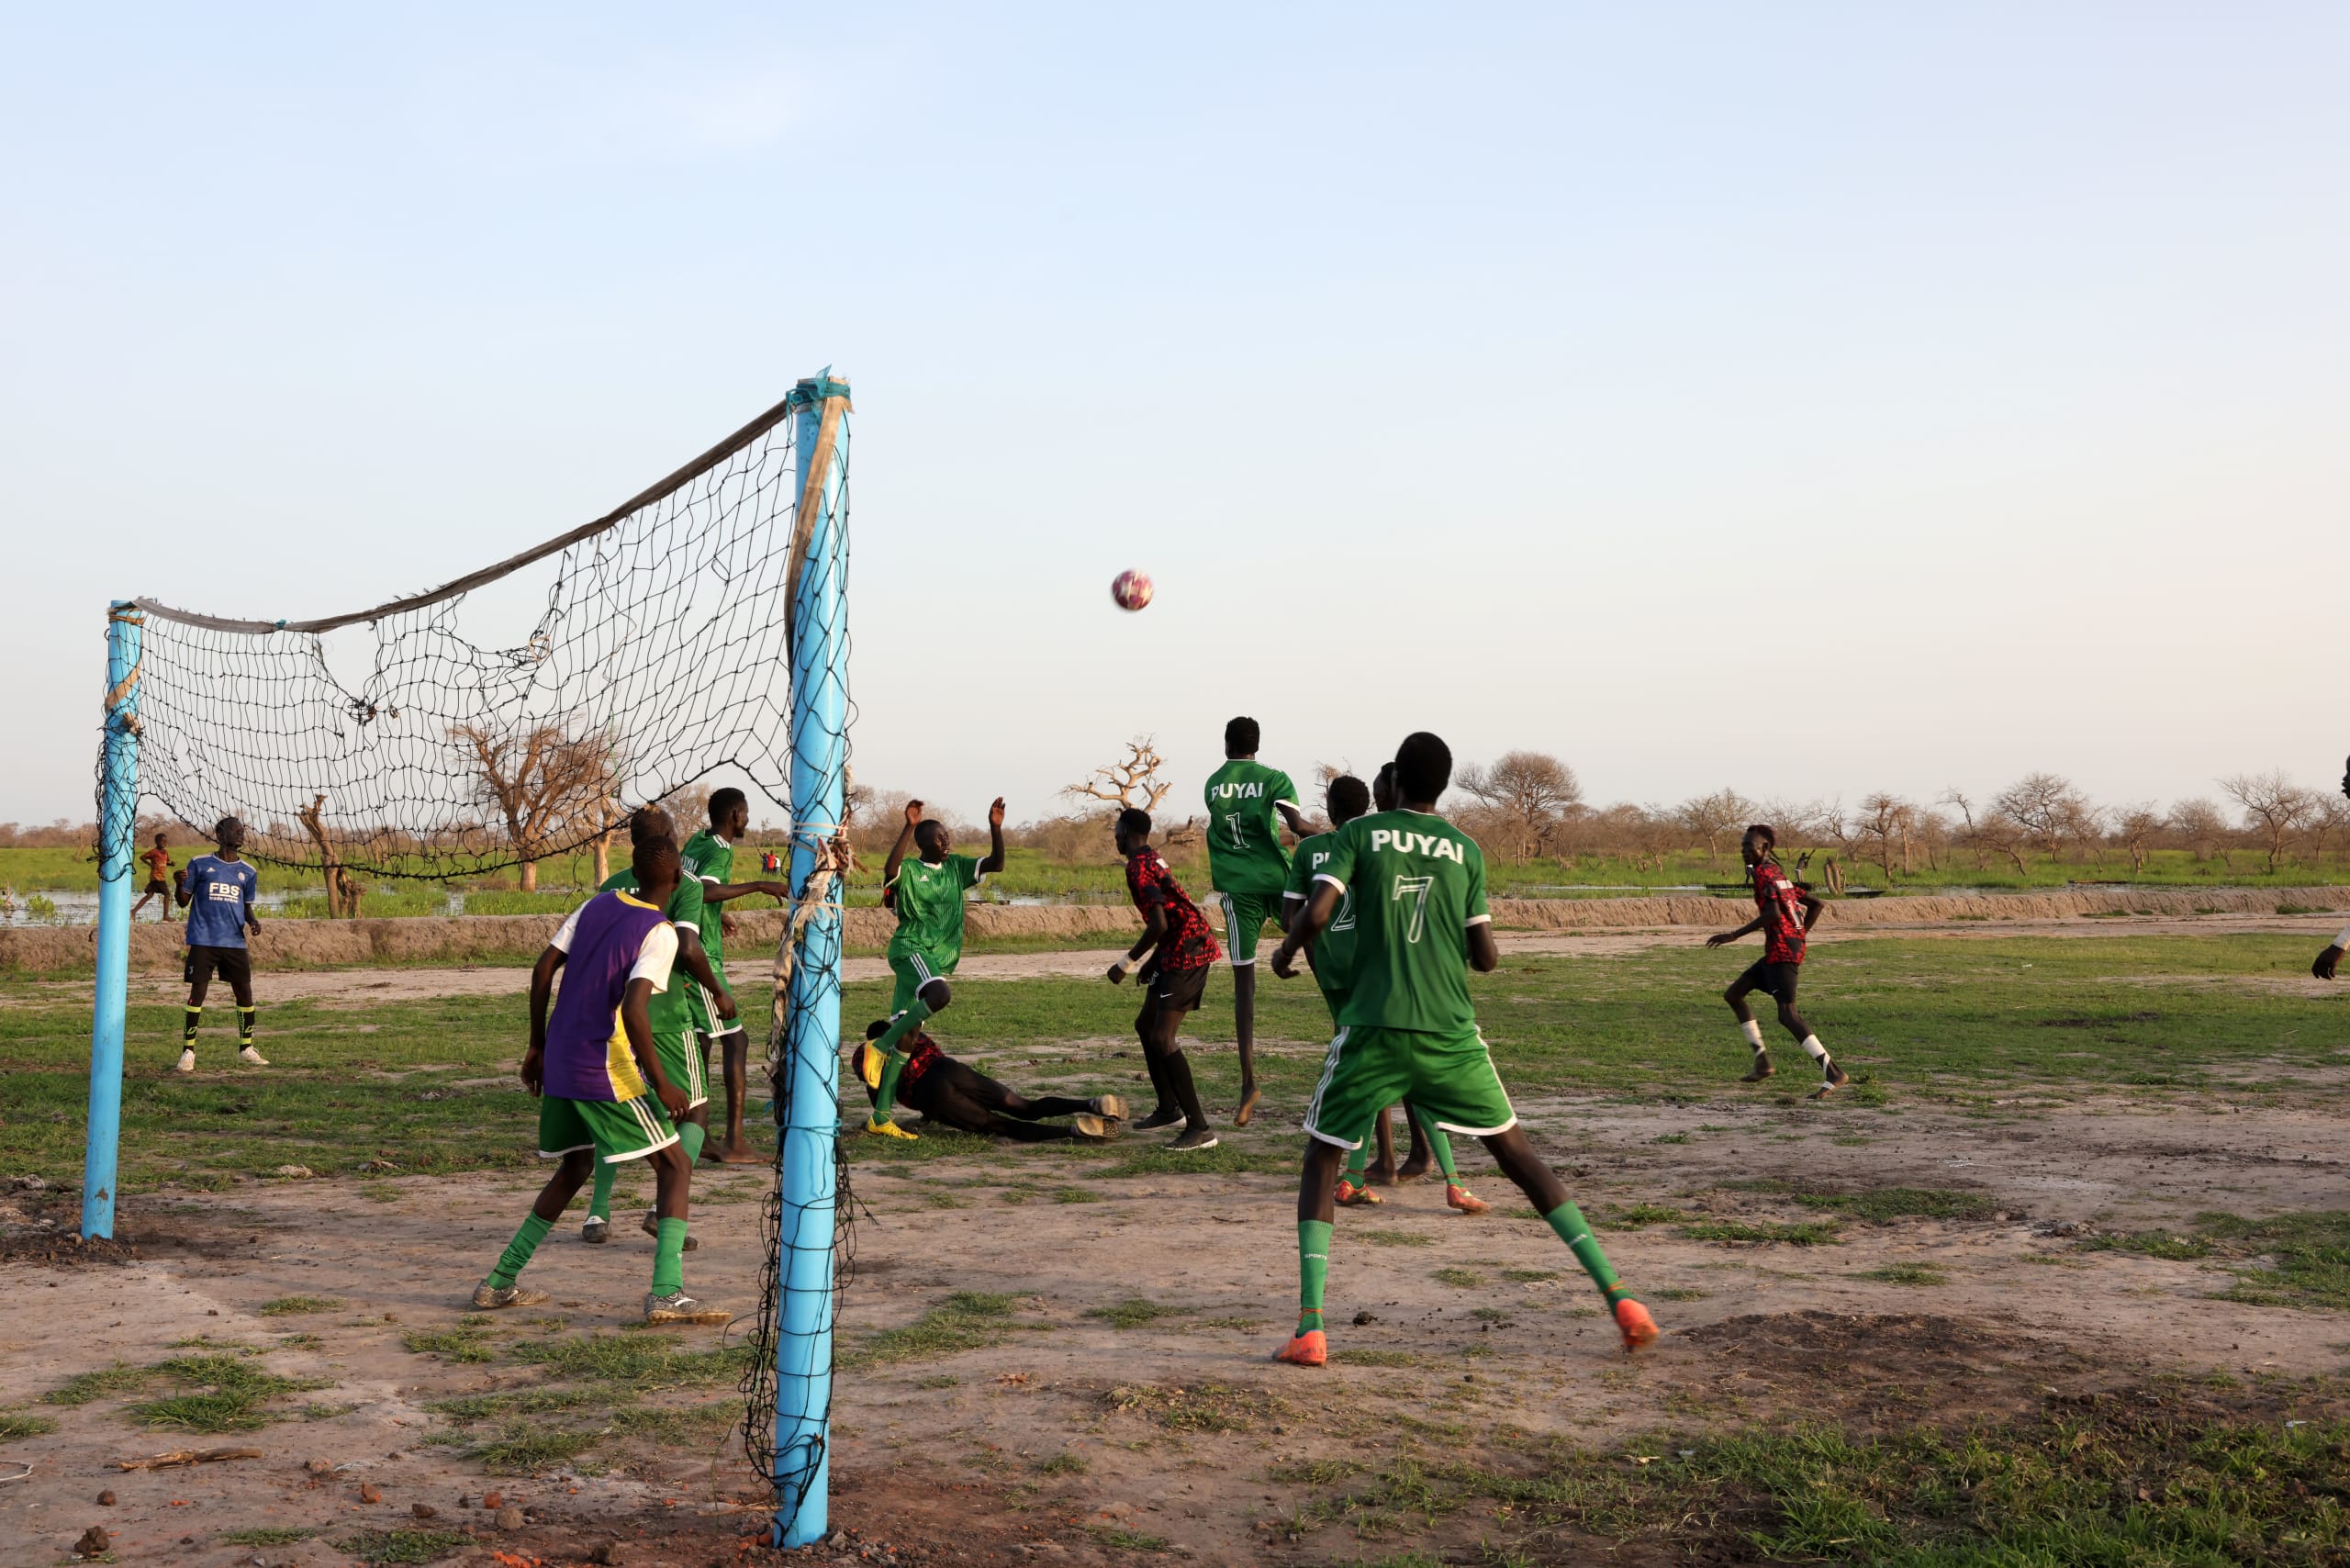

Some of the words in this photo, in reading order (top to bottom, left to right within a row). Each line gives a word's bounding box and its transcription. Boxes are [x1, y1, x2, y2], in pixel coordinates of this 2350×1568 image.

[1211, 782, 1264, 802] PUYAI
[1226, 812, 1251, 850] 1
[1371, 829, 1464, 865] PUYAI
[209, 882, 240, 897] FBS
[1330, 884, 1357, 932] 2
[1392, 874, 1435, 944] 7
